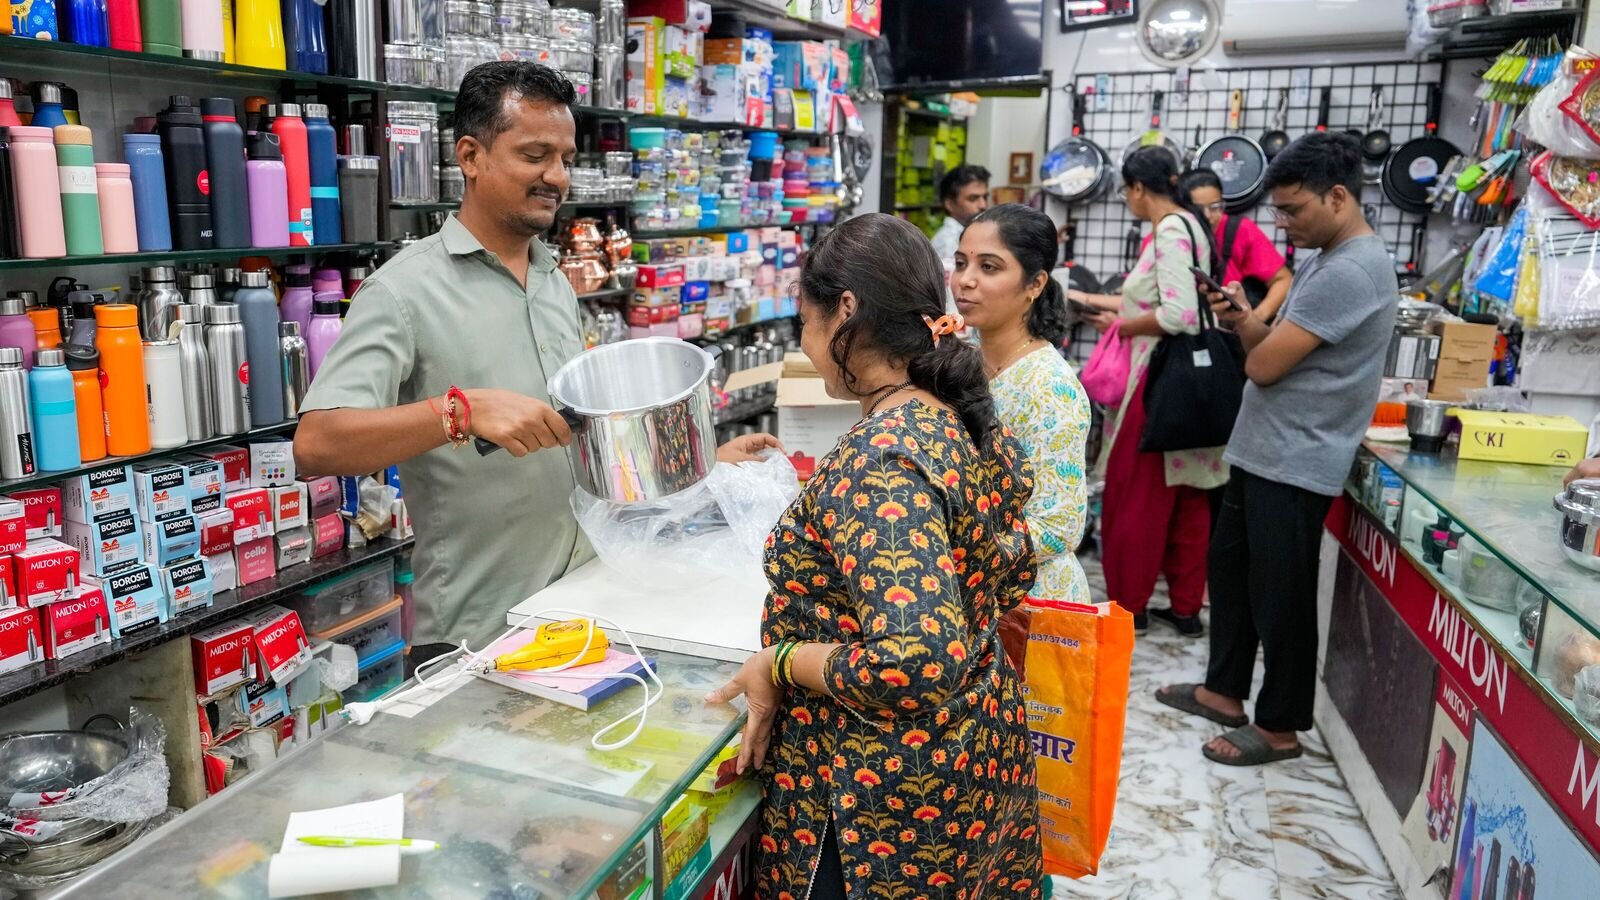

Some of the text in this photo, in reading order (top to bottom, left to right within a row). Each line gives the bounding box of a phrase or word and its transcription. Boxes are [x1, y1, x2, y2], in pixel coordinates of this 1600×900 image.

[90, 467, 124, 481] BOROSIL
[153, 471, 183, 483] BOROSIL
[20, 496, 43, 506] ILTON
[233, 498, 255, 509] MILTON
[281, 500, 299, 511] cello
[101, 518, 134, 532] BOROSIL
[165, 518, 193, 531] BOROSIL
[0, 541, 22, 554] MILTO
[244, 546, 267, 560] cello
[1348, 506, 1397, 588] MILTON
[30, 558, 60, 571] MILTON
[172, 563, 203, 580] BOROSIL
[112, 571, 149, 590] BOROSIL
[56, 602, 87, 619] MILTON
[262, 626, 287, 647] MILTON
[210, 640, 238, 657] MILTON
[1428, 592, 1509, 715] MILTON
[1442, 683, 1469, 726] MILTON
